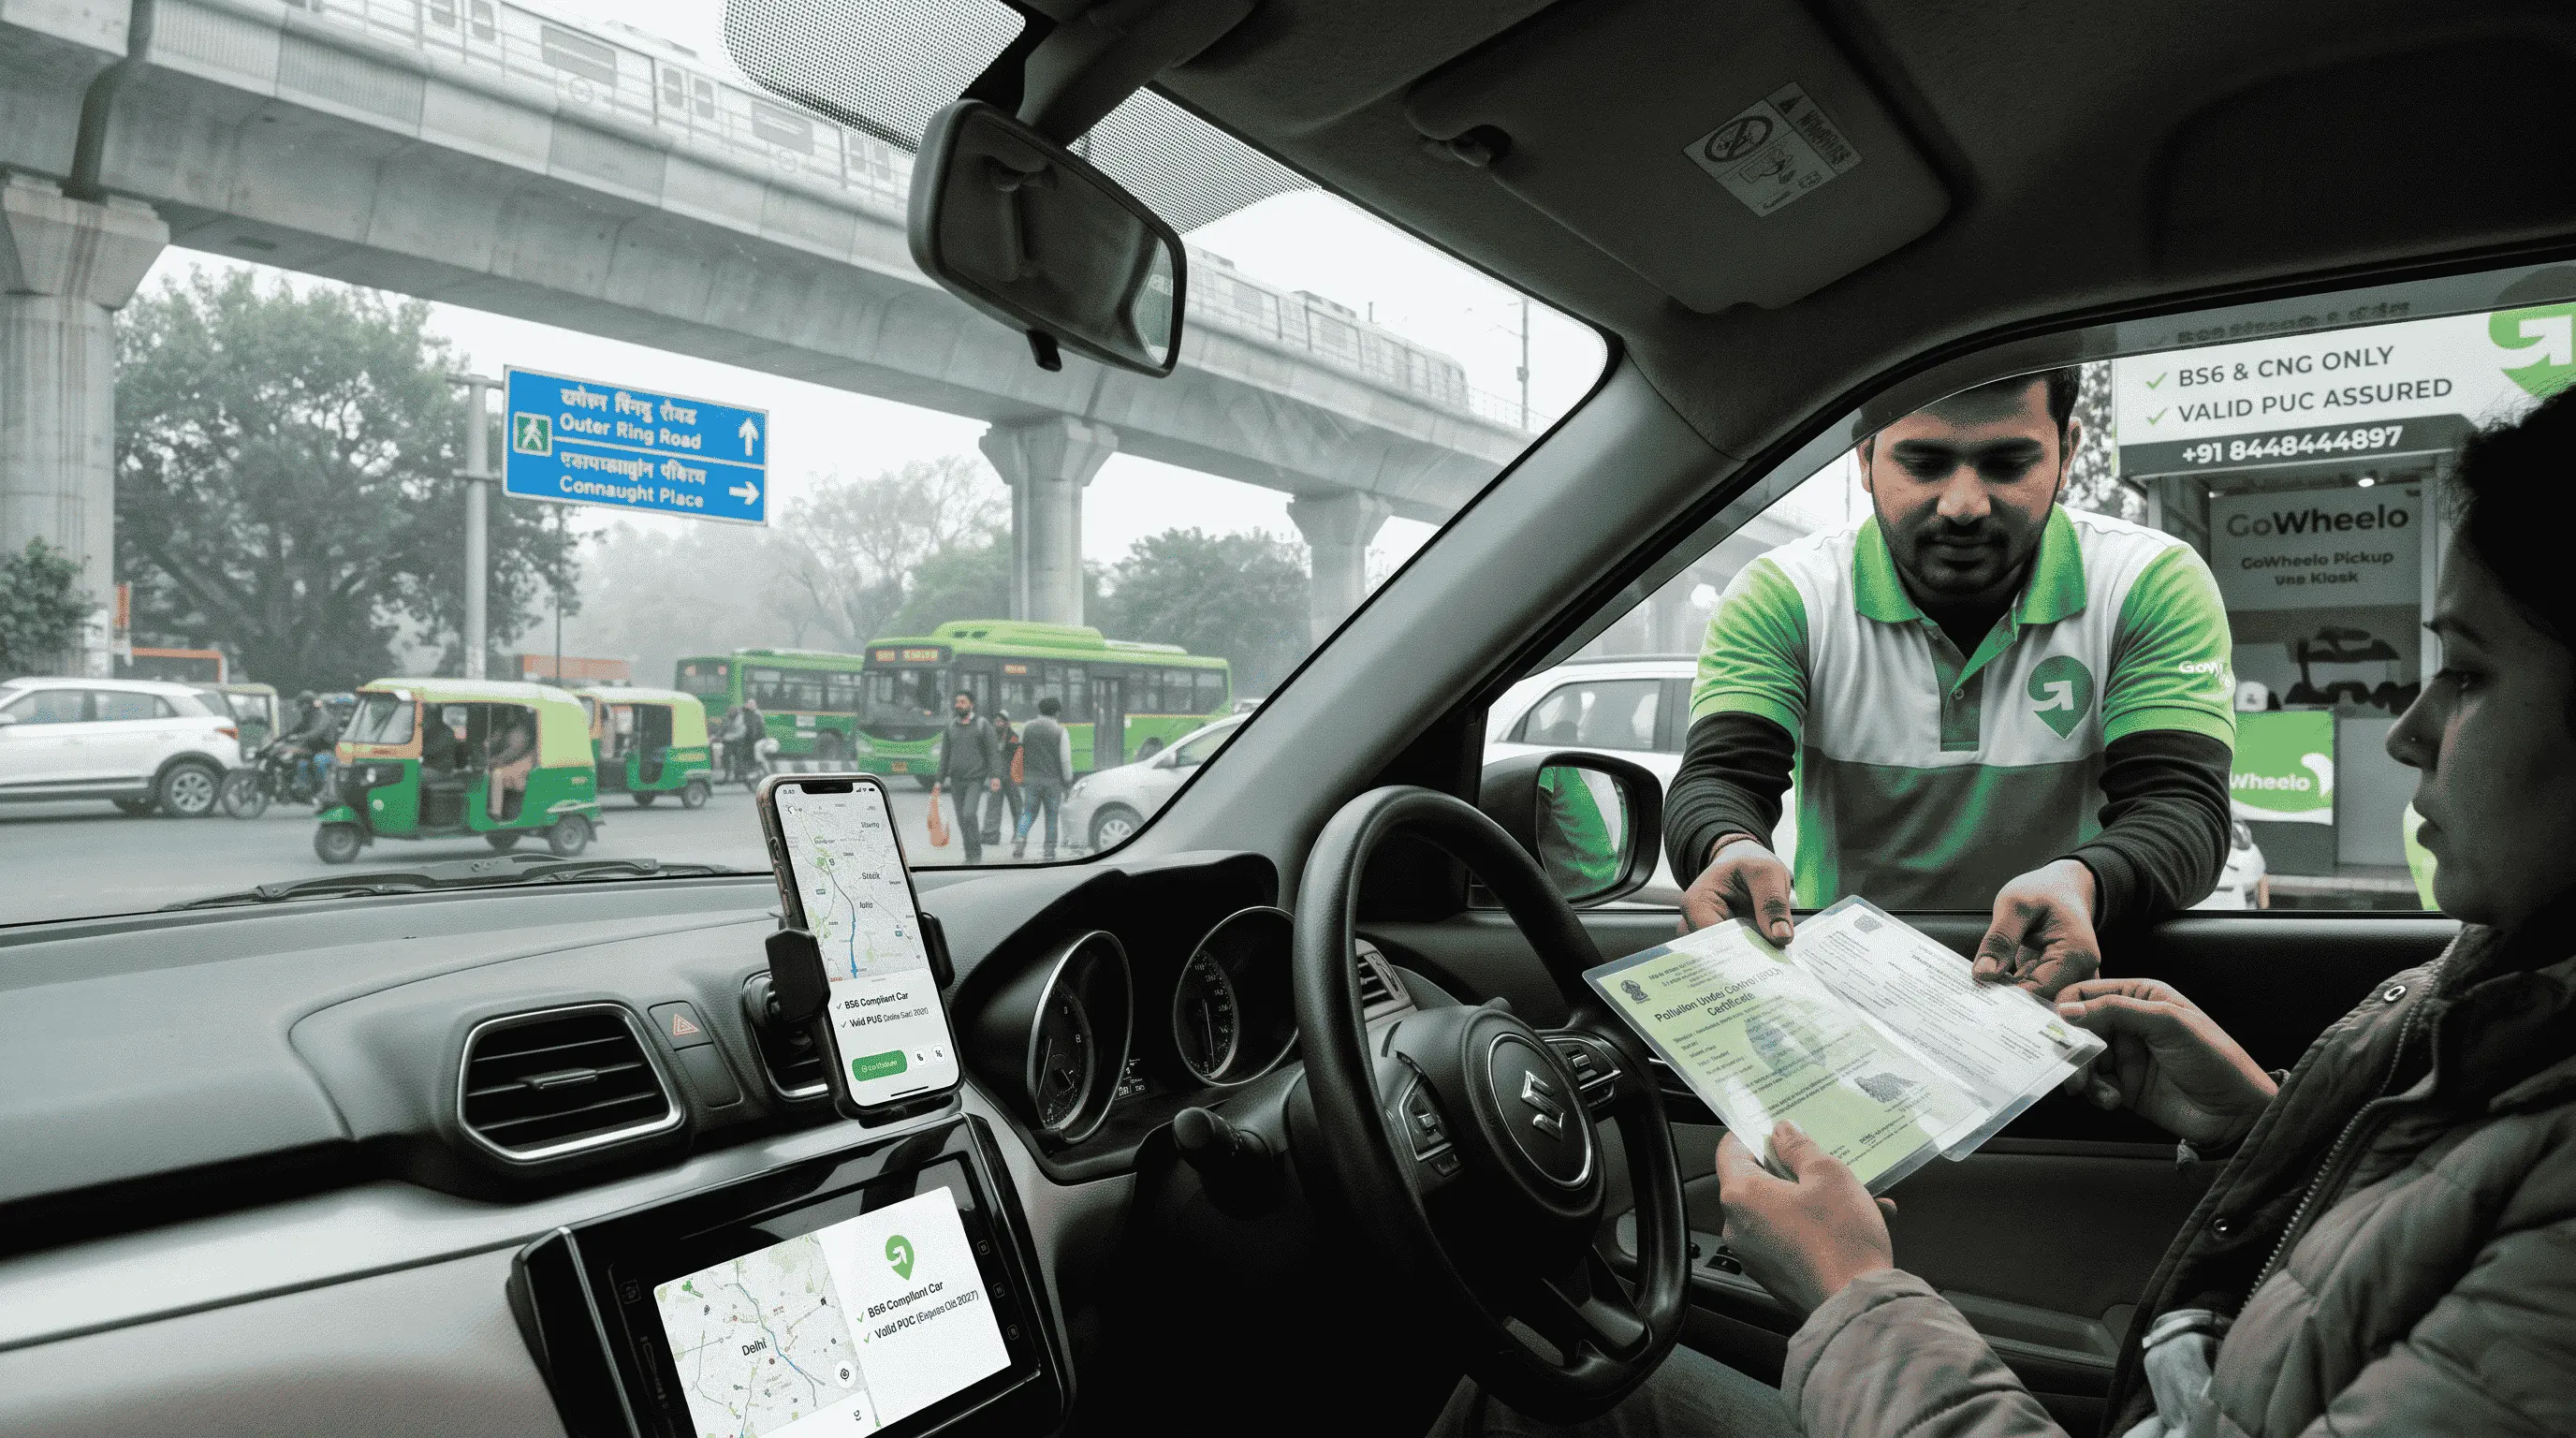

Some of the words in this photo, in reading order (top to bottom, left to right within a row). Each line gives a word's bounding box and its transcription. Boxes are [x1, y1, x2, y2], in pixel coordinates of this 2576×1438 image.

[2178, 366, 2224, 388] BS6
[2233, 362, 2249, 381] &
[2258, 355, 2314, 378] CNG
[2321, 345, 2395, 372] ONLY
[2177, 399, 2253, 423] VALID
[2261, 391, 2315, 415] PUC
[2322, 377, 2453, 409] ASSURED
[560, 413, 610, 436] Outer
[616, 421, 654, 446] Ring
[660, 428, 702, 449] Road
[2182, 441, 2222, 464] +91
[2229, 425, 2405, 462] 8448444897
[560, 475, 654, 504] Connaught
[660, 487, 704, 508] Place
[2226, 504, 2409, 539] GoWheelo
[2334, 550, 2394, 565] Pickup
[896, 991, 909, 1001] Car
[929, 1282, 944, 1293] Car
[741, 1338, 768, 1357] Delhi
